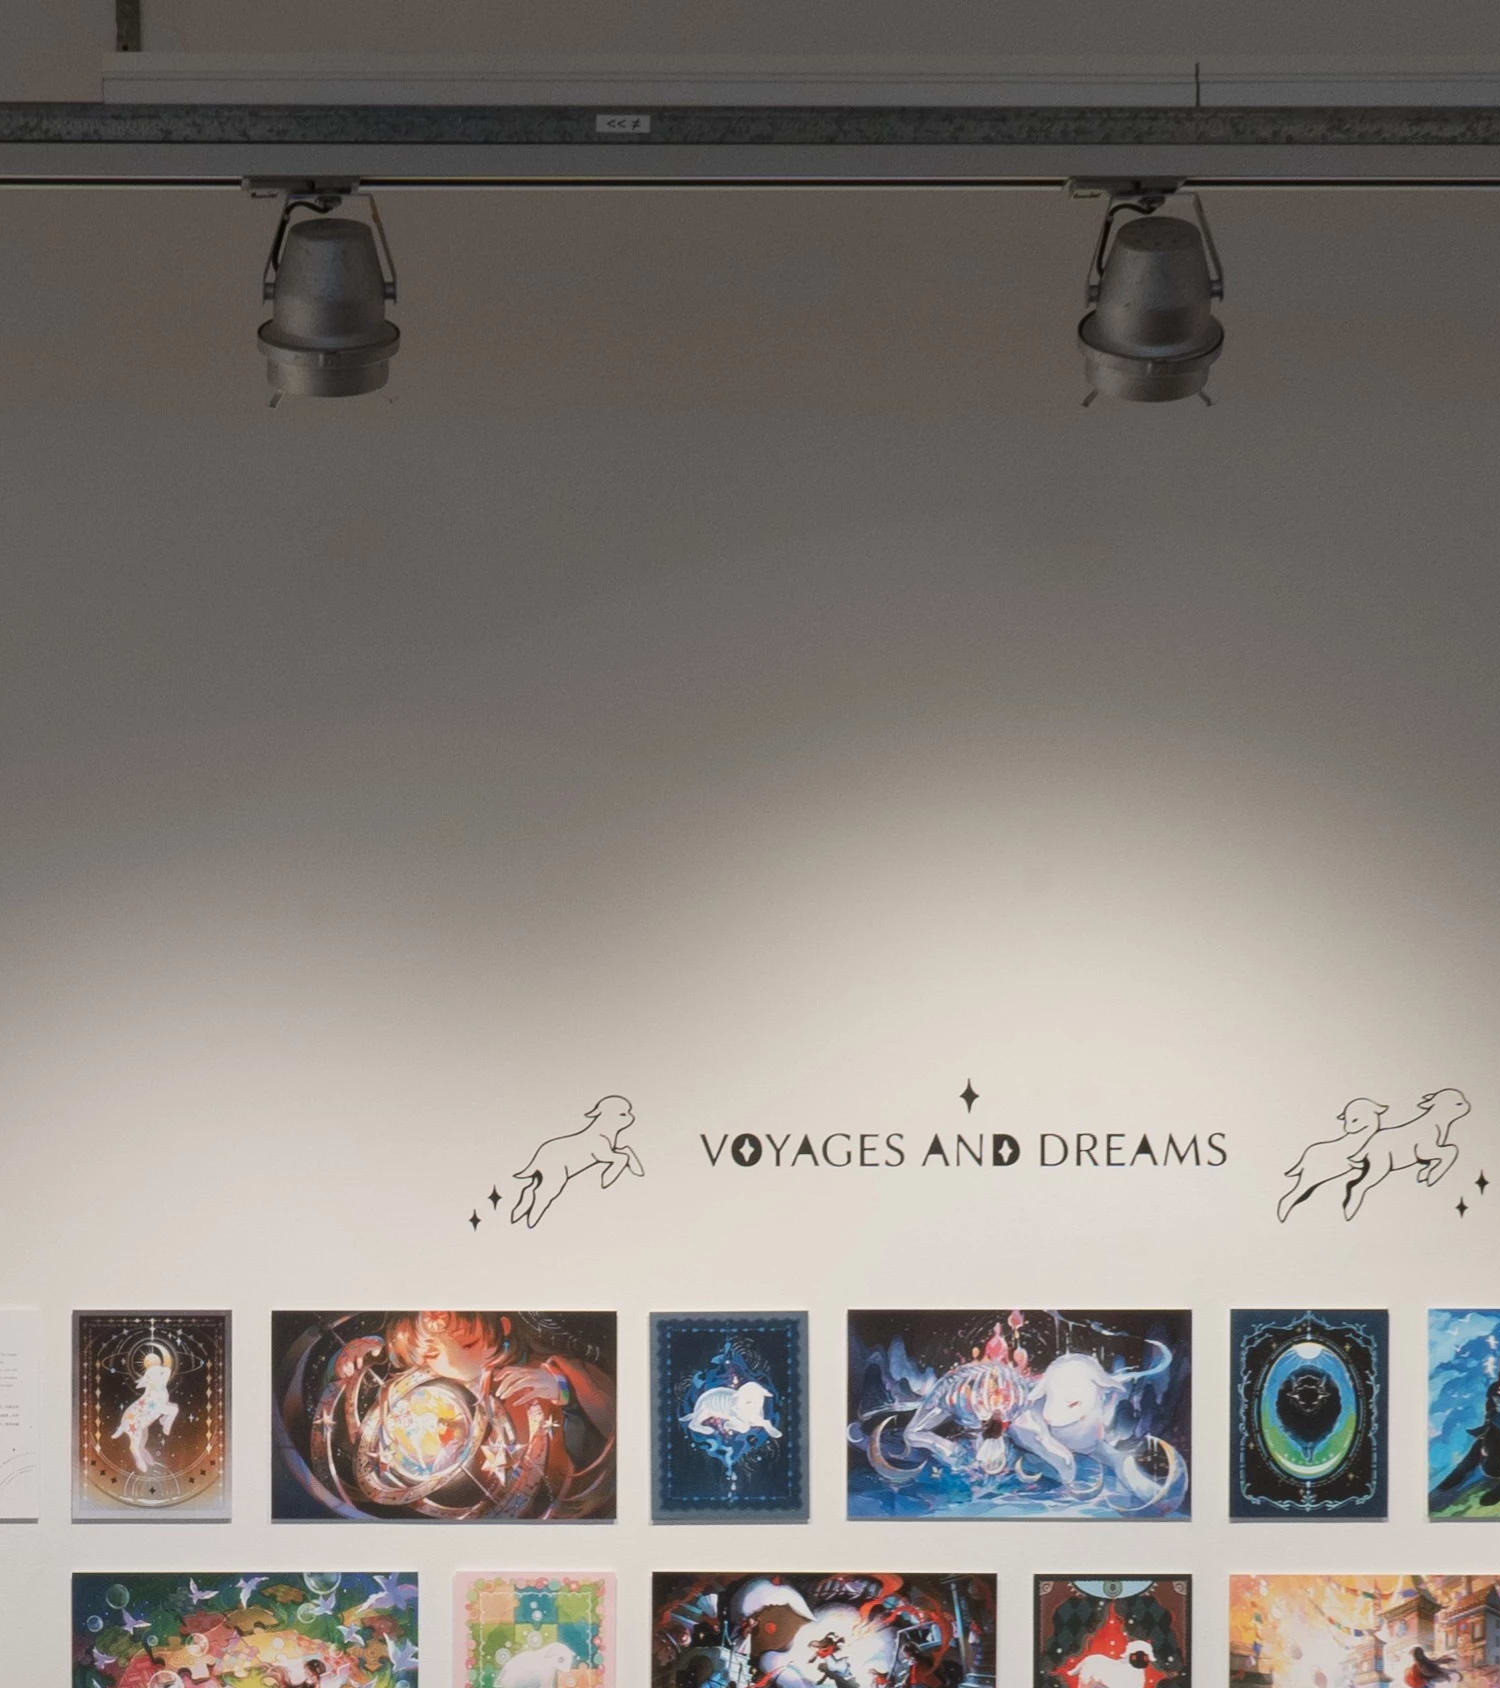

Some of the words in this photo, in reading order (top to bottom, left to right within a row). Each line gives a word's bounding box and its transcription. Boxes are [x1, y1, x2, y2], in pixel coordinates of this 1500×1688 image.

[700, 1132, 905, 1167] VOYAGES
[921, 1132, 1021, 1167] AND
[1039, 1132, 1227, 1167] DREAMS
